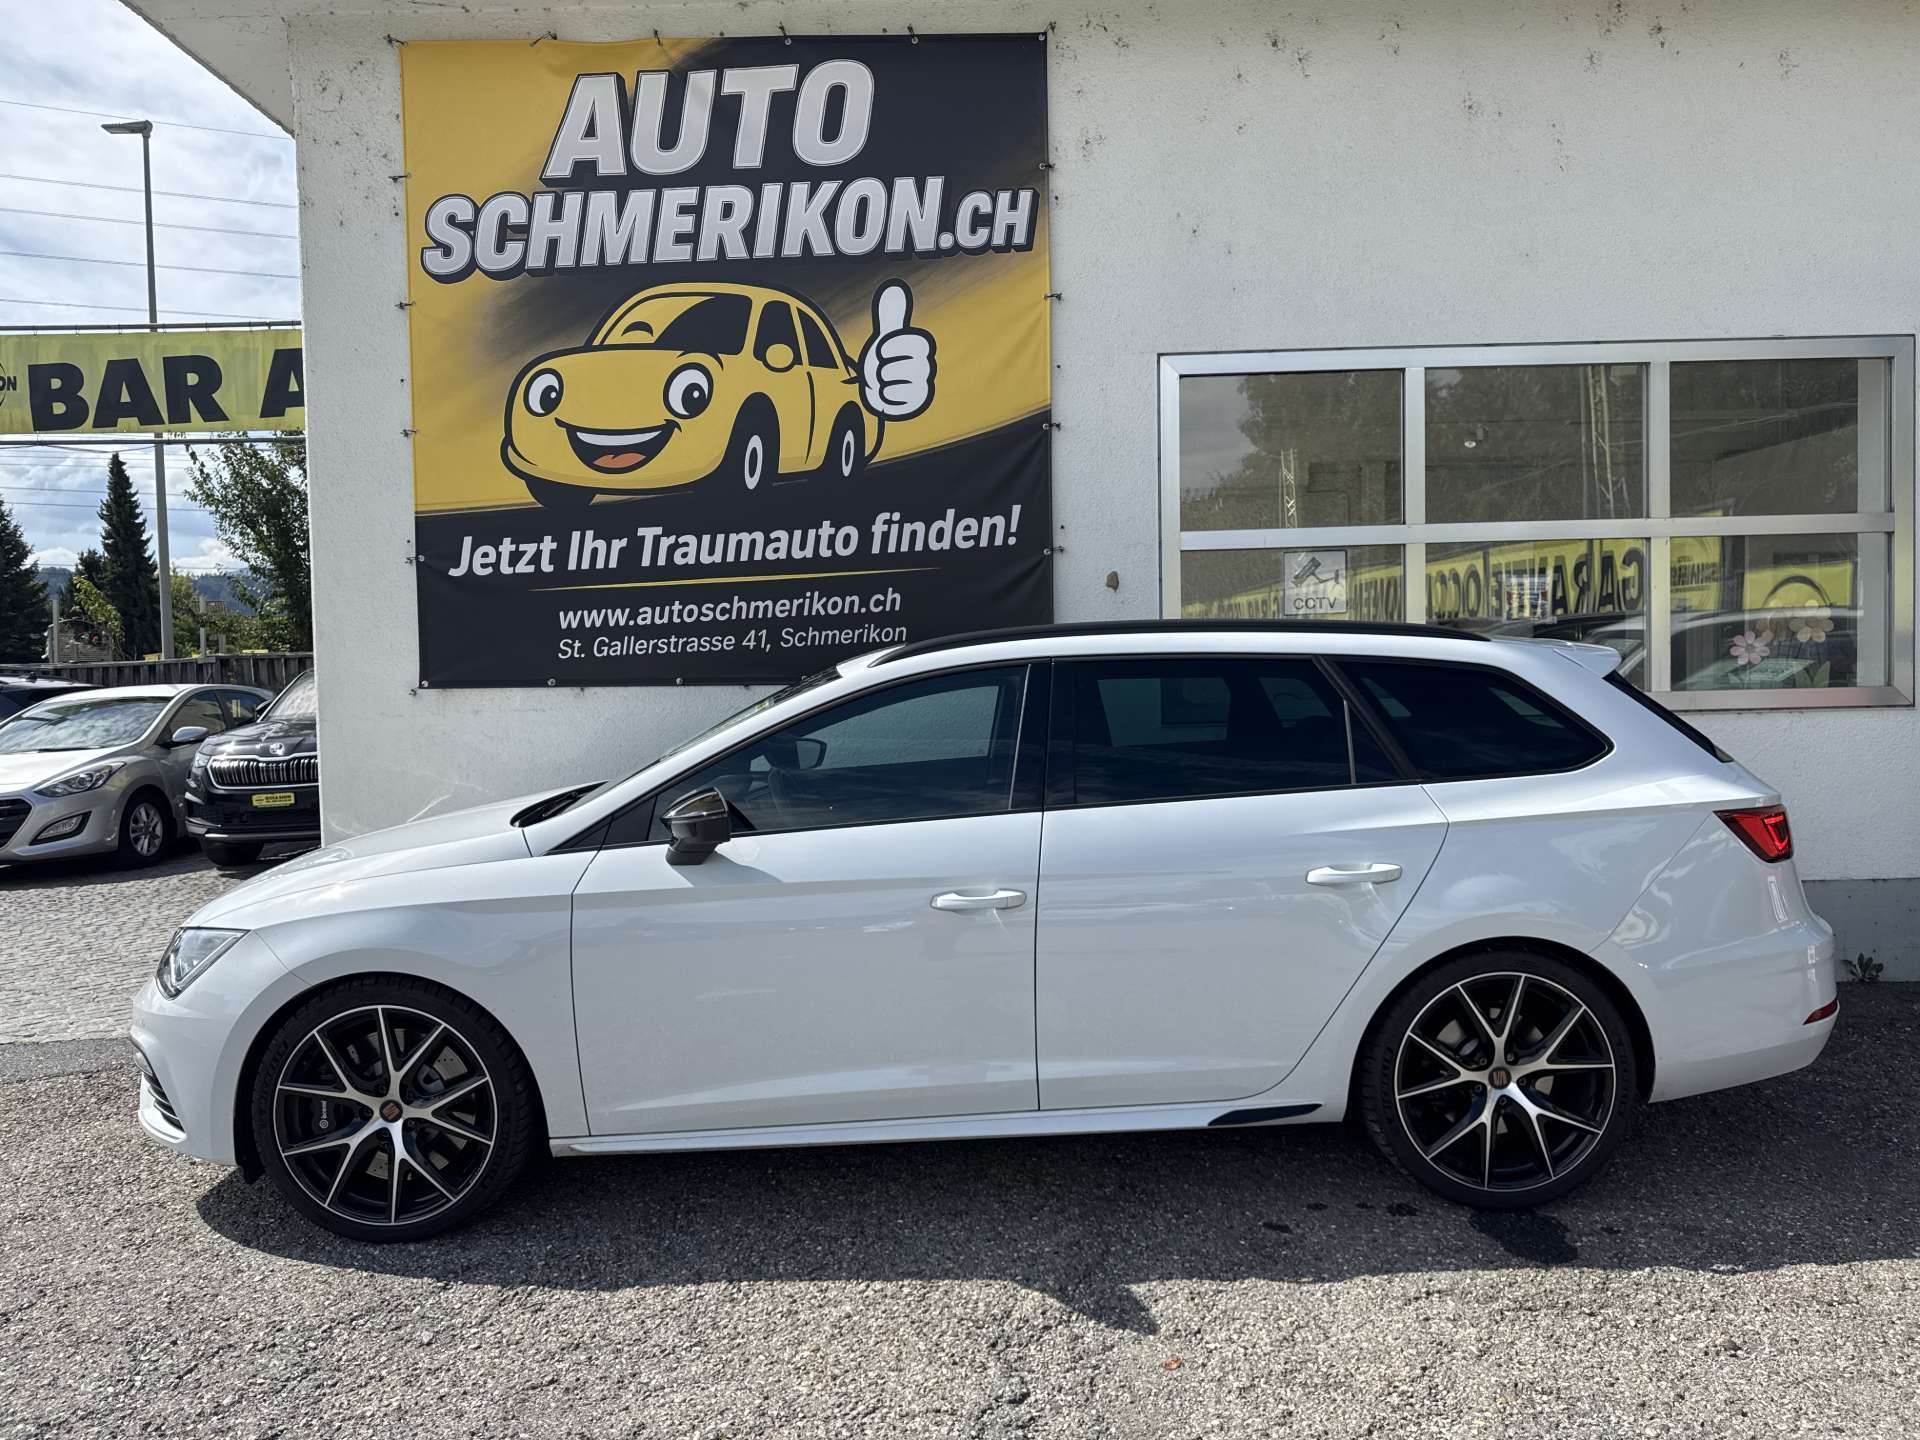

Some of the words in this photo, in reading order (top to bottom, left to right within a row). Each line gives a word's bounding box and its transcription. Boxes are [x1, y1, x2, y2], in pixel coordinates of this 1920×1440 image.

[544, 58, 876, 179] AUTO
[422, 175, 1035, 276] SCHMERIKON.CH
[27, 354, 231, 432] BAR
[447, 535, 558, 577] Jetzt
[567, 529, 628, 571] Ihr
[636, 520, 859, 568] Traumauto
[871, 504, 1022, 555] finden!
[558, 587, 902, 630] www.autoschmerikon.ch
[1292, 596, 1338, 611] CCTV
[557, 638, 586, 659] St.
[593, 634, 736, 657] Gallerstrasse
[741, 628, 772, 653] 41,
[779, 623, 908, 648] Schmerikon
